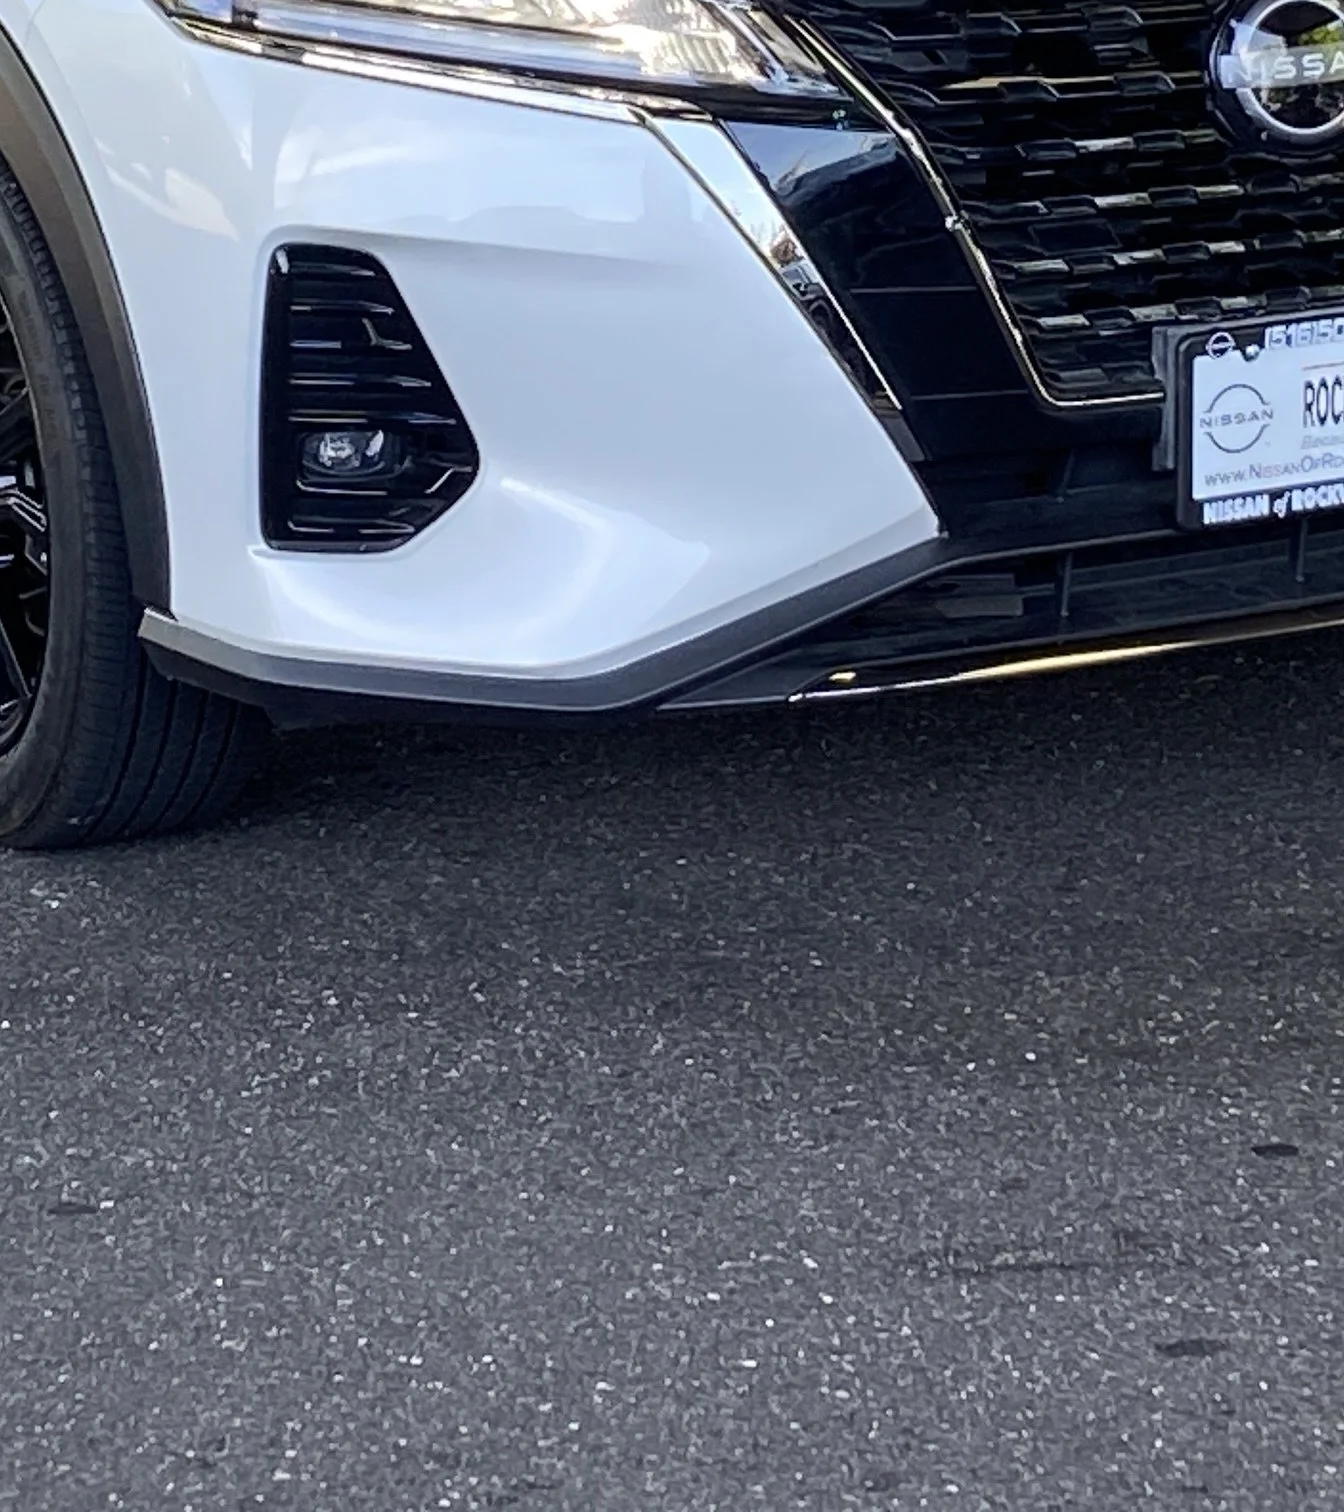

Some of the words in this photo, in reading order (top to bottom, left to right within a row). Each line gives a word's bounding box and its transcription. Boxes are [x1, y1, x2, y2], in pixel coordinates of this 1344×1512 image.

[1199, 408, 1275, 430] NISSAN
[1202, 493, 1270, 525] NISSAN
[1273, 491, 1292, 519] of
